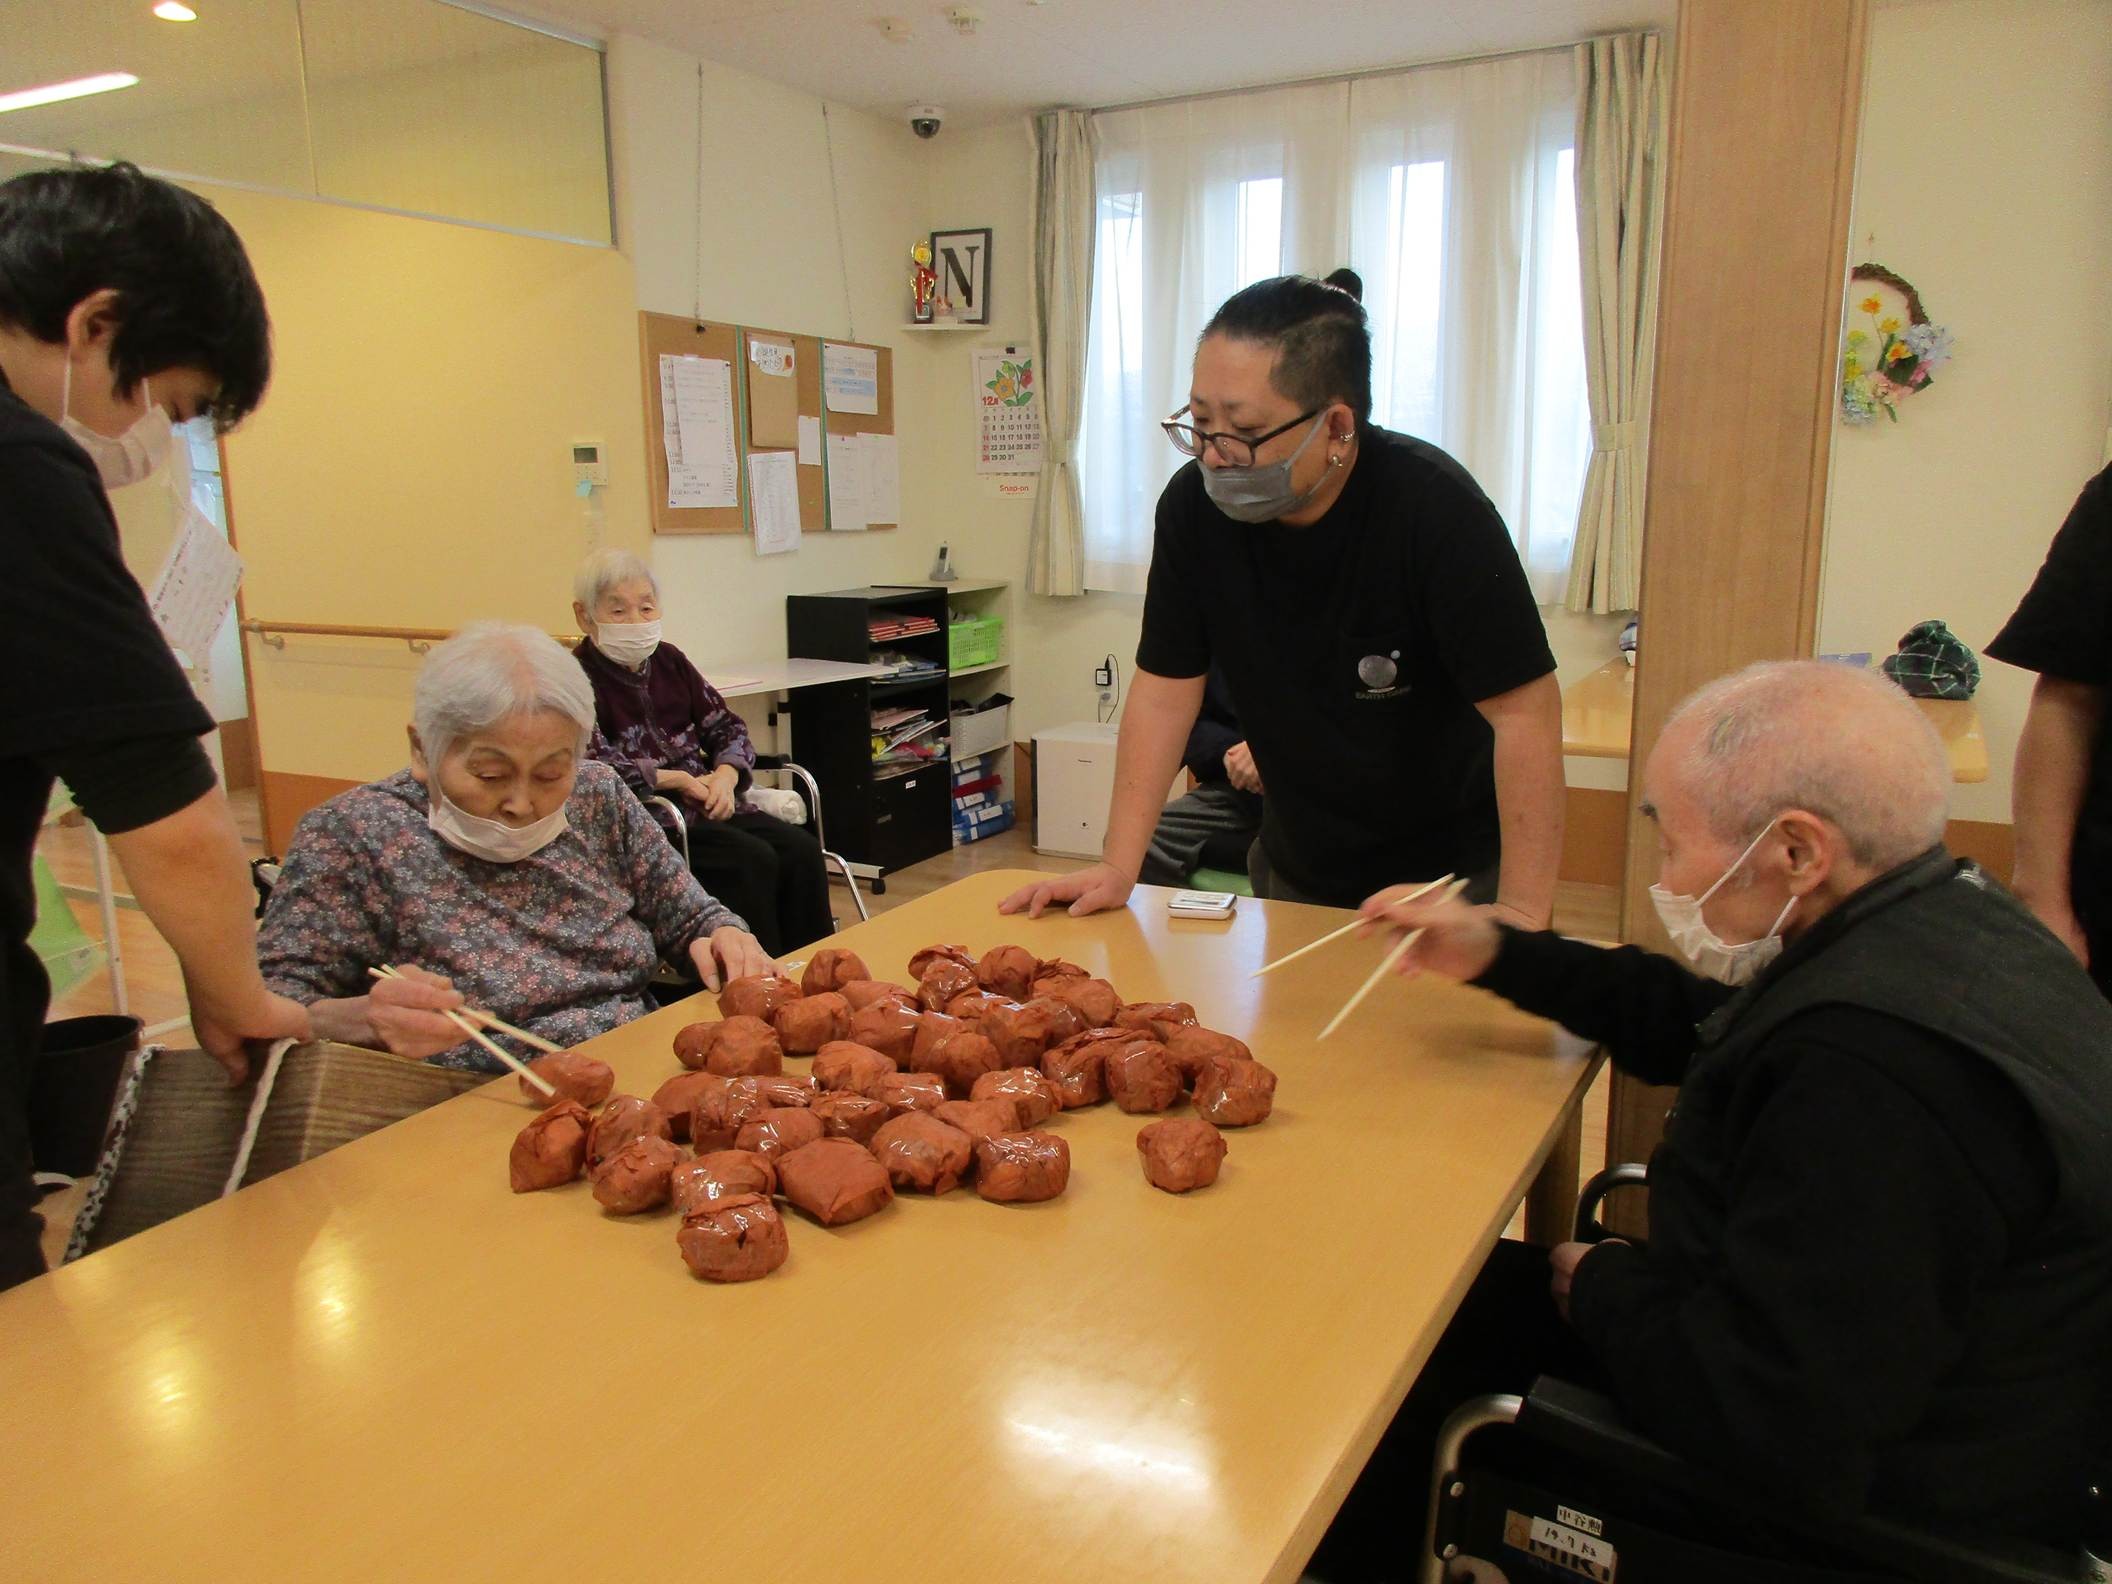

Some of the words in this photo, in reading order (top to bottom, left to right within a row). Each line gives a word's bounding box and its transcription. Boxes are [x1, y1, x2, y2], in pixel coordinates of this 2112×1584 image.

[940, 246, 979, 308] N
[983, 396, 998, 405] 12月
[1000, 484, 1028, 492] Snap-on
